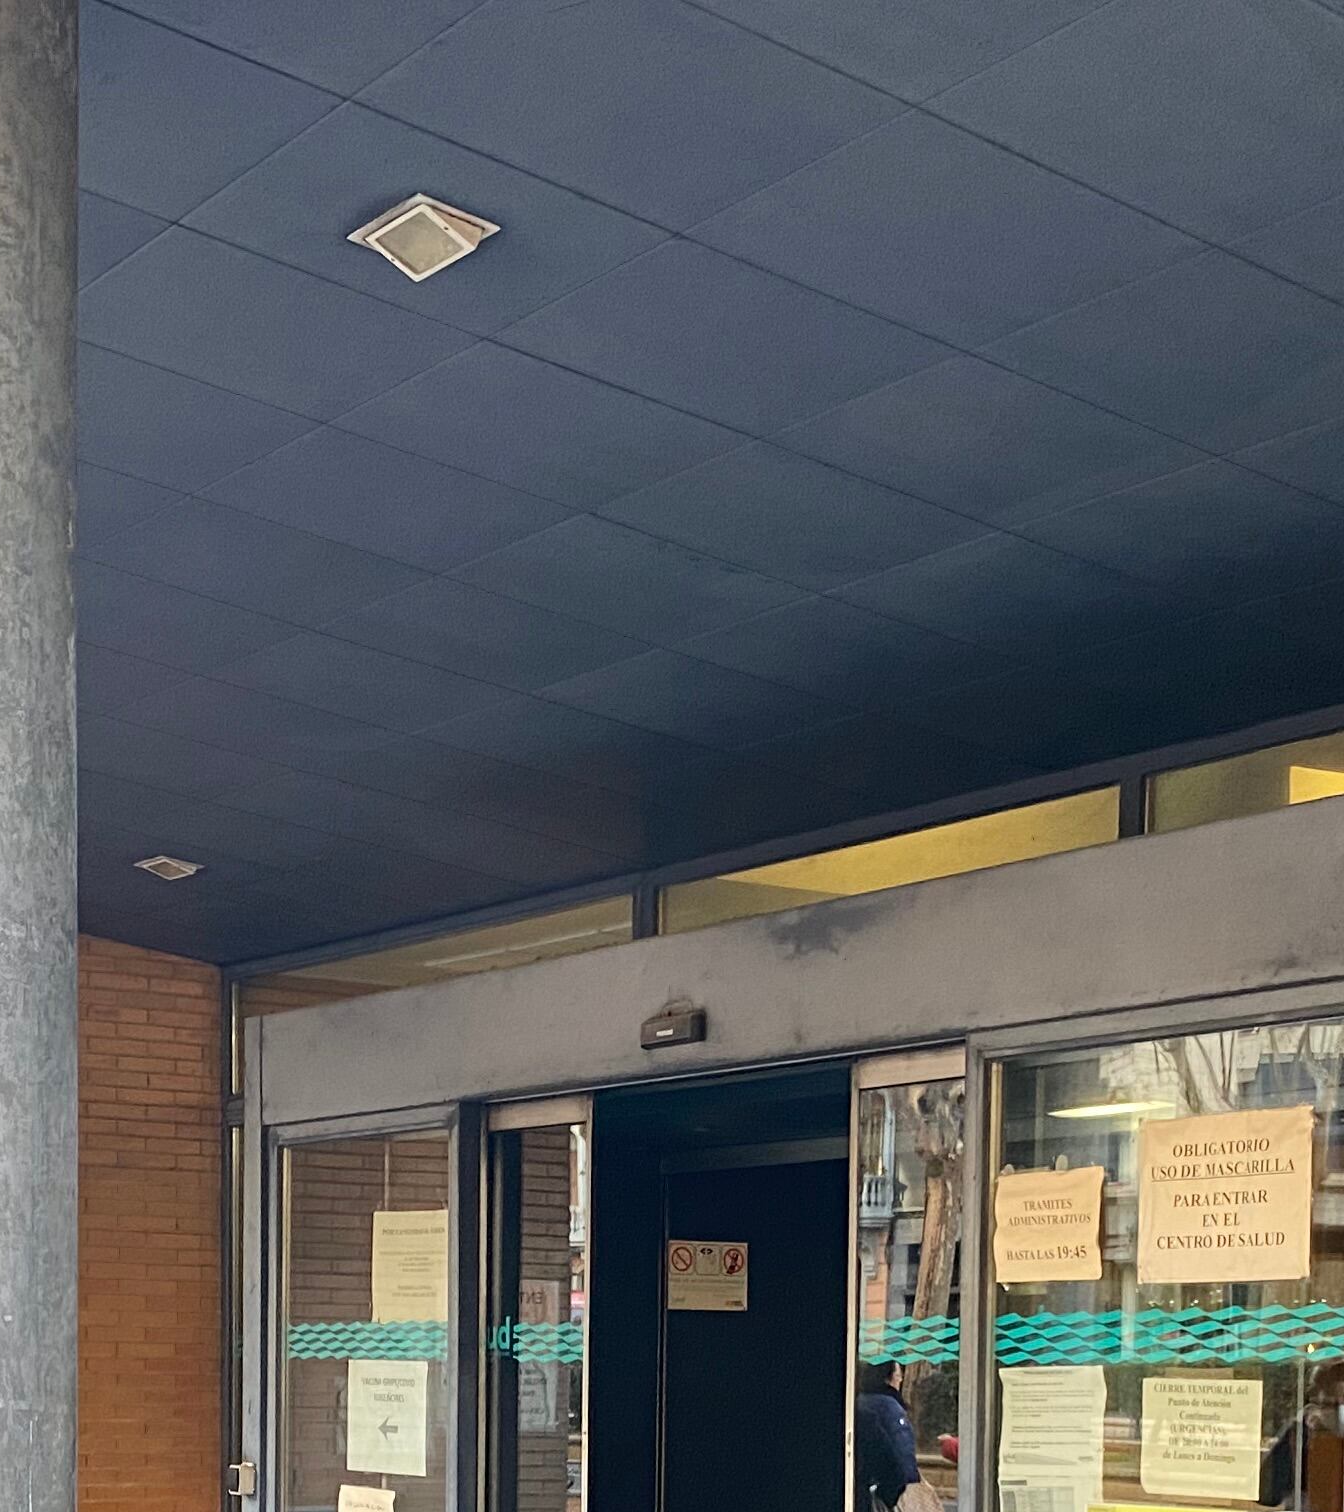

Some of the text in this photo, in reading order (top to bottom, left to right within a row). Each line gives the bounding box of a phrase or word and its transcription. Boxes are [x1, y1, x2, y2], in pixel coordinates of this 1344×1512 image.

[1172, 1138, 1270, 1158] OBLIGATORIO
[1151, 1158, 1295, 1180] USO DE MASCARILLA
[1173, 1189, 1269, 1208] PARA ENTRAR
[1007, 1213, 1091, 1227] ADMINISTRATIVOS
[1202, 1212, 1240, 1228] EN EL
[1157, 1231, 1285, 1250] CENTRO DE SALUD
[1006, 1244, 1088, 1261] HASTA LAS 19:45
[1154, 1383, 1186, 1394] CIERRE
[1188, 1384, 1234, 1395] TEMPORAL
